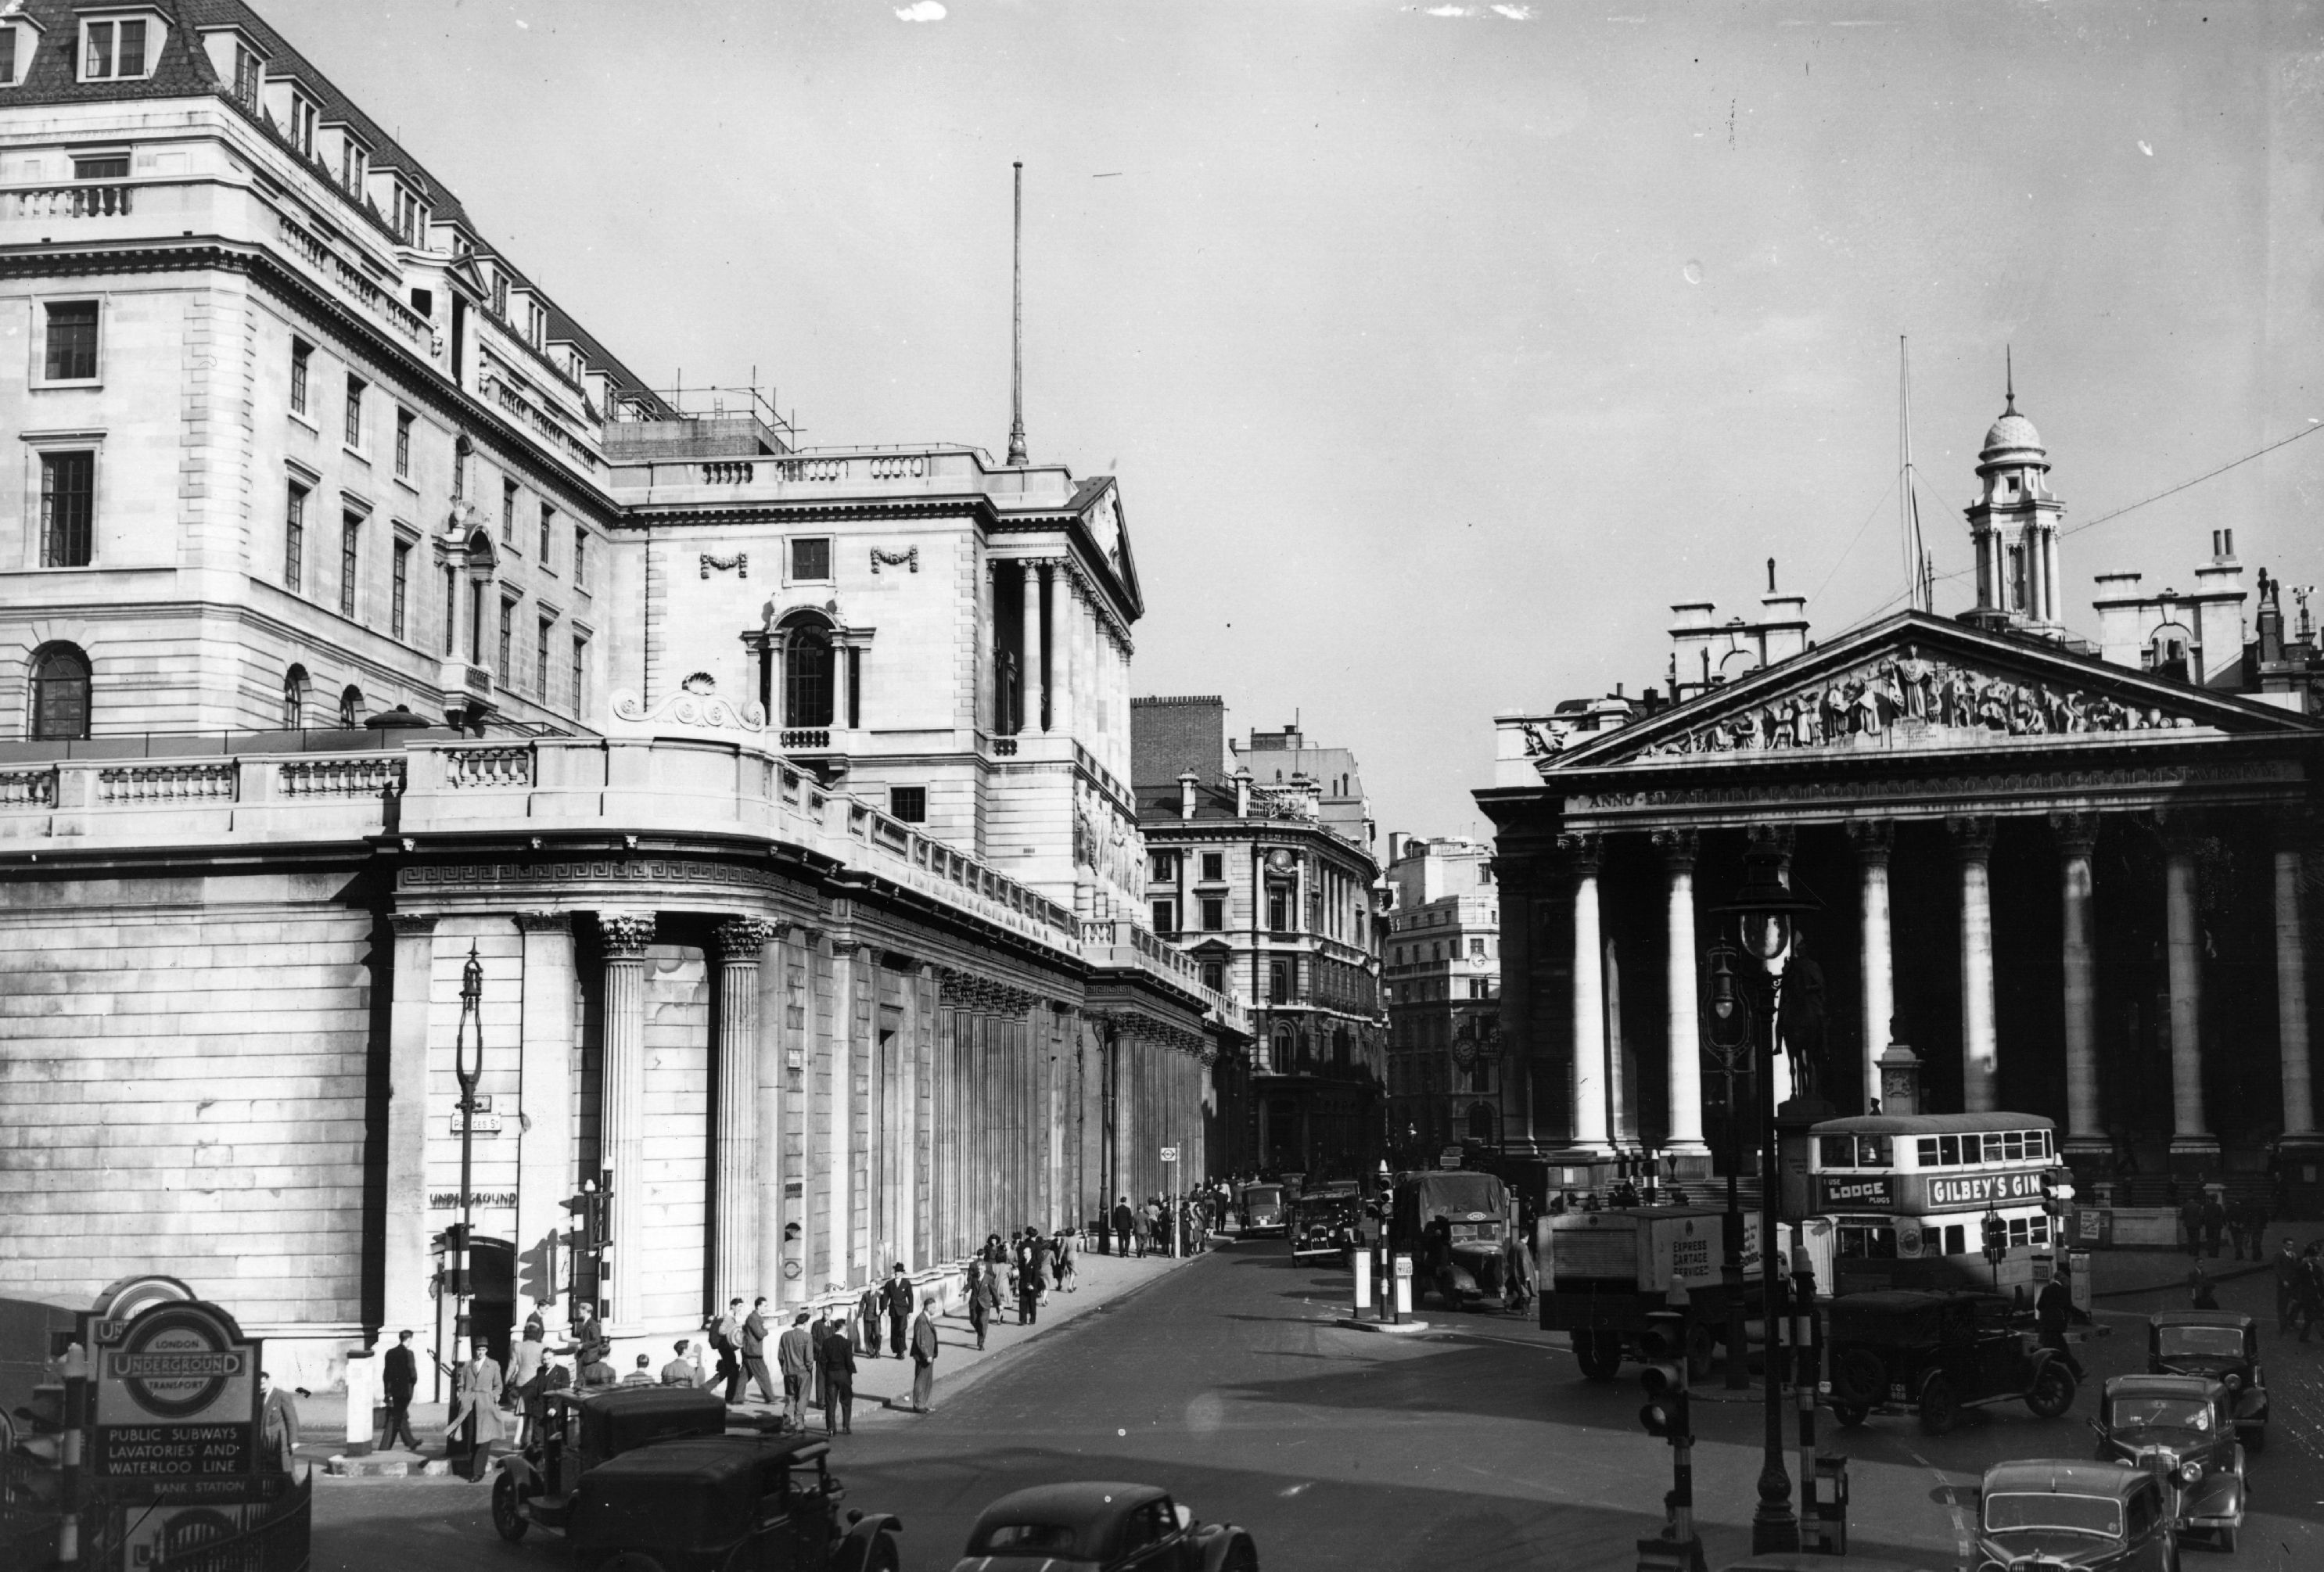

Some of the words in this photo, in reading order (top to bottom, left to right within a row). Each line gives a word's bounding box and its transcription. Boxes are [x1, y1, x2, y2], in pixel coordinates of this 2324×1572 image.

[1589, 793, 1633, 807] ANNO
[1829, 1182, 1884, 1201] LODGE
[1934, 1176, 2007, 1203] GILBEY'S
[2012, 1174, 2042, 1197] GIN
[429, 1193, 518, 1207] UNDEGROUND
[1868, 1197, 1891, 1205] PLUGS
[1672, 1240, 1708, 1253] EXPRESS
[1672, 1253, 1708, 1265] CARTAGE
[1673, 1265, 1709, 1277] SERVICES
[156, 1340, 199, 1349] LONDON
[114, 1355, 240, 1375] UNDERGROUND
[149, 1381, 203, 1390] TRANSPORT
[110, 1428, 161, 1442] PUBLIC
[171, 1427, 237, 1441] SUBWAYS
[109, 1444, 195, 1459] LAVATORIES
[203, 1443, 237, 1456] AND
[109, 1460, 192, 1474] WATERLOO
[203, 1459, 237, 1473] LINE
[153, 1482, 189, 1494] BANK
[195, 1480, 246, 1492] STATION
